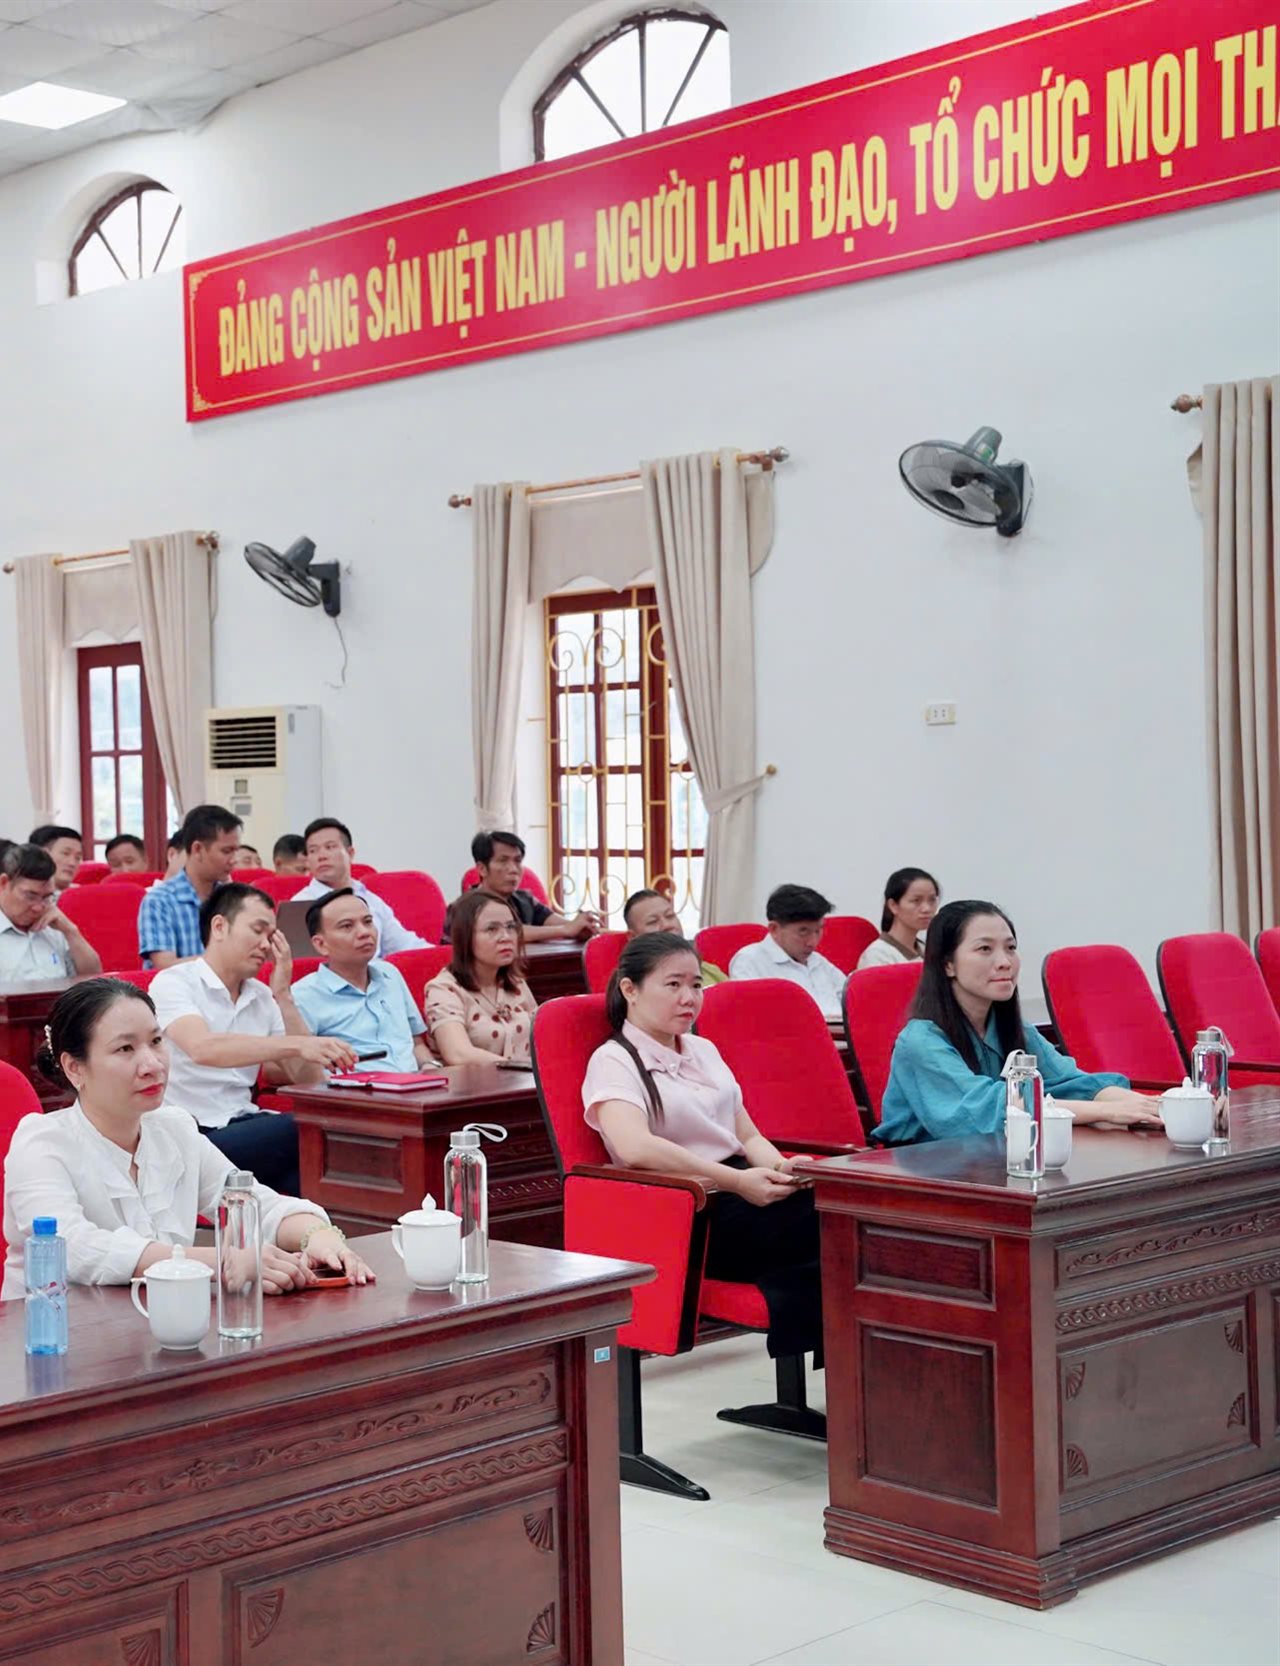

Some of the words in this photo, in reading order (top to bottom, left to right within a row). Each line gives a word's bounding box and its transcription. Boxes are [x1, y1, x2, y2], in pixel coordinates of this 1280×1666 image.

[219, 279, 285, 376] ĐẢNG
[289, 267, 360, 372] CỘNG
[366, 238, 422, 342] SẢN
[428, 228, 488, 338] VIỆT
[495, 219, 566, 312] NAM
[573, 250, 588, 270] -
[595, 170, 696, 289] NGƯỜI
[707, 156, 800, 264] LÃNH
[810, 136, 898, 253] ĐẠO,
[909, 76, 962, 216] TỔ
[972, 67, 1090, 201] CHỨC
[1106, 47, 1199, 178] MỌI
[1214, 25, 1280, 140] TH
